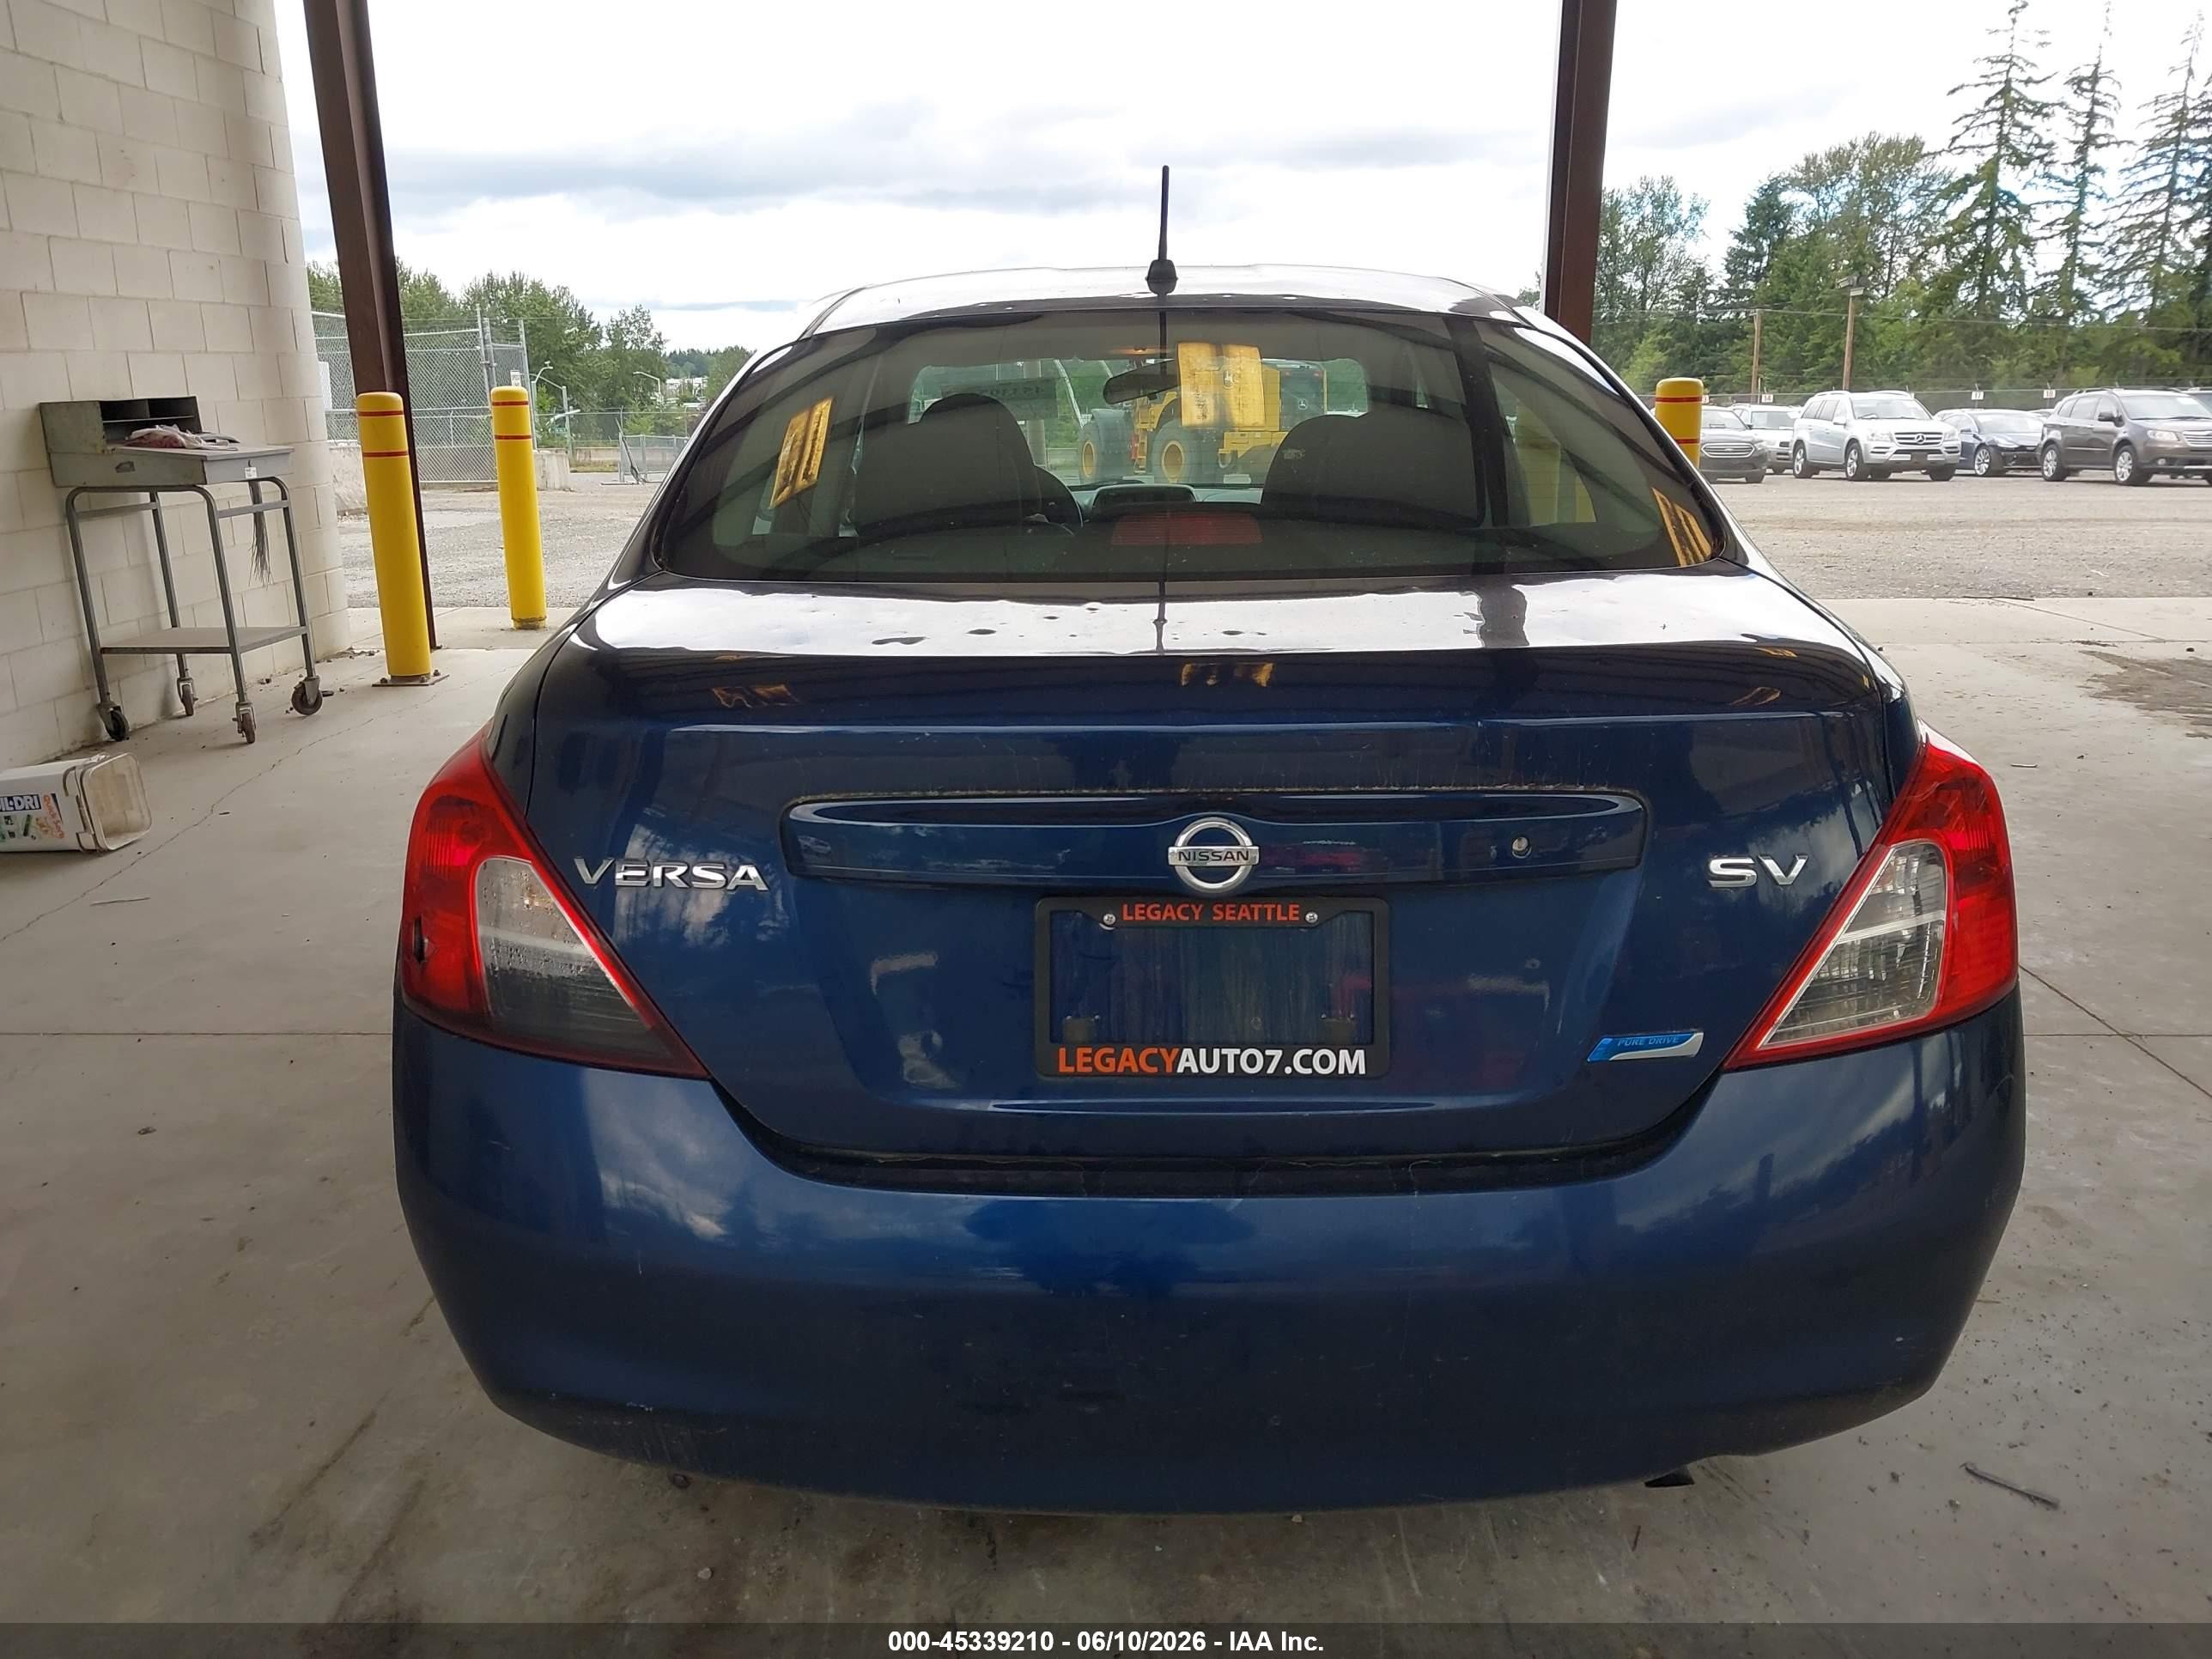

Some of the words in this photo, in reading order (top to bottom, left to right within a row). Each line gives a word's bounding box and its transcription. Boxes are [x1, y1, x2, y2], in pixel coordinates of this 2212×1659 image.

[0, 795, 40, 811] IL-DRI
[1178, 850, 1249, 861] NISSAN
[574, 858, 769, 891] VERSA
[1708, 854, 1809, 888] SV
[1122, 903, 1203, 921] LEGACY
[1212, 903, 1299, 921] SEATTLE
[1617, 1038, 1646, 1047] PURE
[1648, 1036, 1680, 1045] DRIVE
[1058, 1047, 1366, 1074] LEGACYAUTO7.COM
